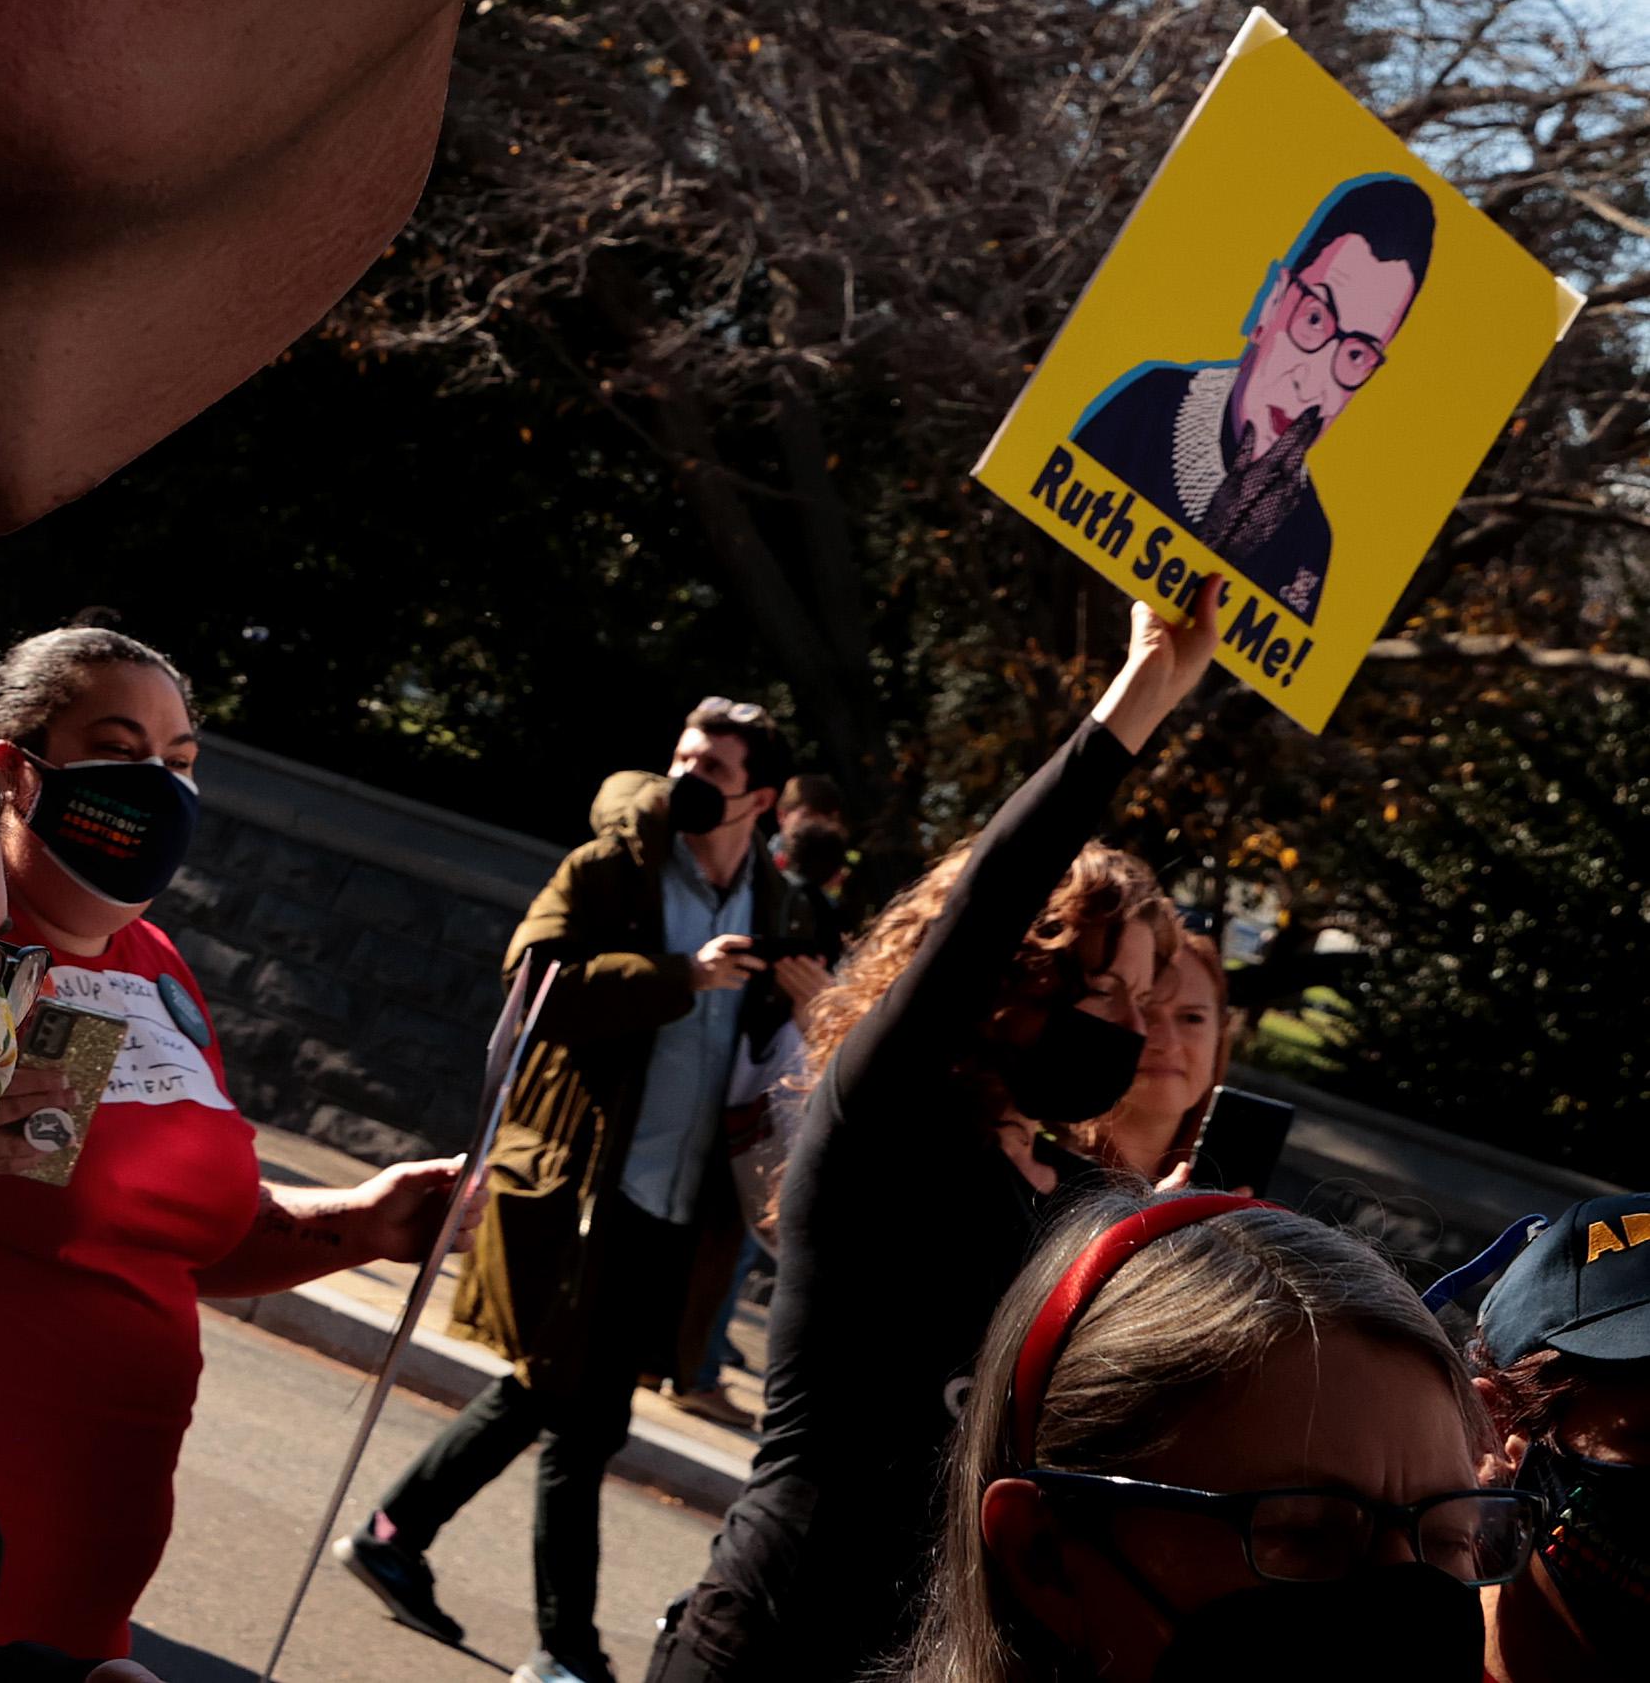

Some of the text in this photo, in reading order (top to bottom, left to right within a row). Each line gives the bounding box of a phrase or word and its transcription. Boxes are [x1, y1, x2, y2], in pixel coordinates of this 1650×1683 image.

[1030, 445, 1138, 559] Ruth
[1222, 595, 1314, 688] Me!
[61, 812, 132, 846] ABORTION
[68, 799, 137, 834] ABORTION
